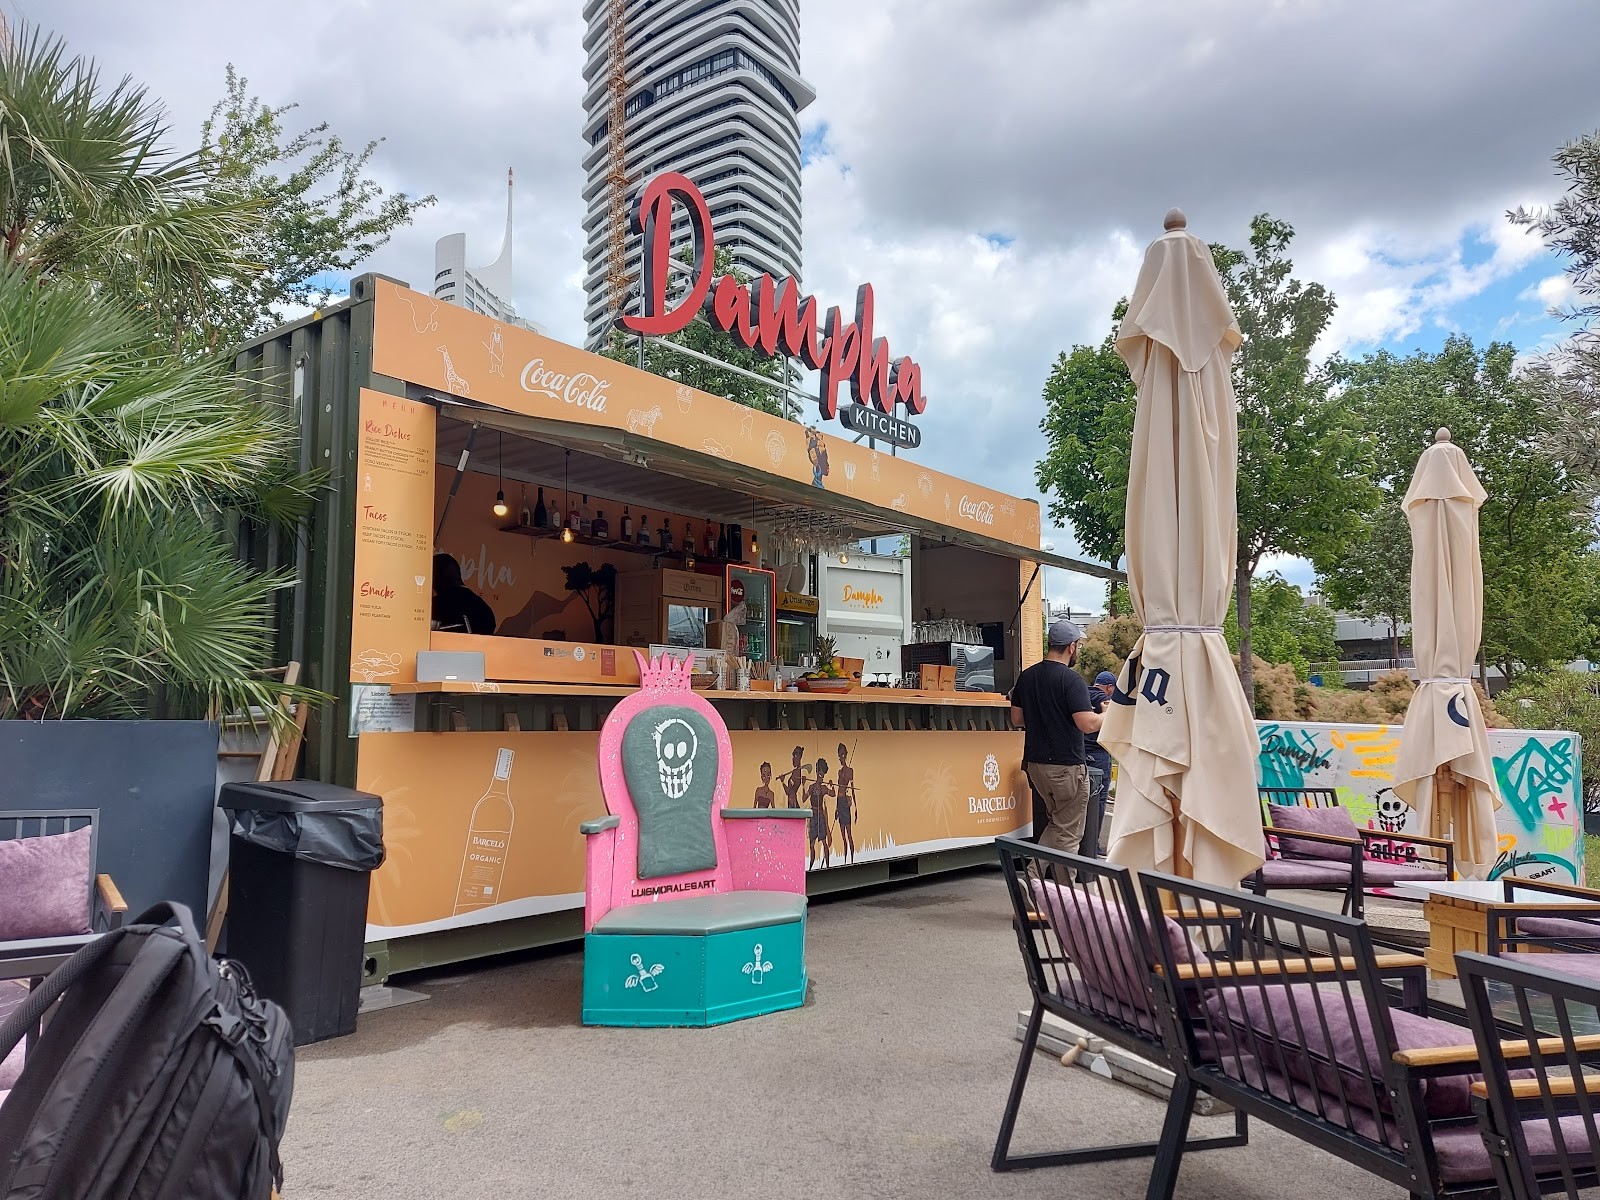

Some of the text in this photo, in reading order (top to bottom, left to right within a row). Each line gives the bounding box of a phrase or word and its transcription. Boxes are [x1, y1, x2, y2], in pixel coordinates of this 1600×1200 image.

[618, 172, 927, 420] Dampha
[520, 358, 612, 412] Coca-Cola
[365, 419, 411, 440] Rice Dishes
[855, 407, 916, 444] KITCHEN
[363, 505, 388, 521] Tacos
[958, 495, 995, 525] Coca-Cola
[360, 581, 395, 599] Snacks
[841, 584, 884, 606] Dampha
[1261, 734, 1332, 770] Dampha
[967, 790, 1016, 814] BARCELÓ
[472, 836, 505, 849] BARCELÓ
[469, 853, 502, 865] ORGANIC
[630, 879, 717, 898] LUISMORALESART
